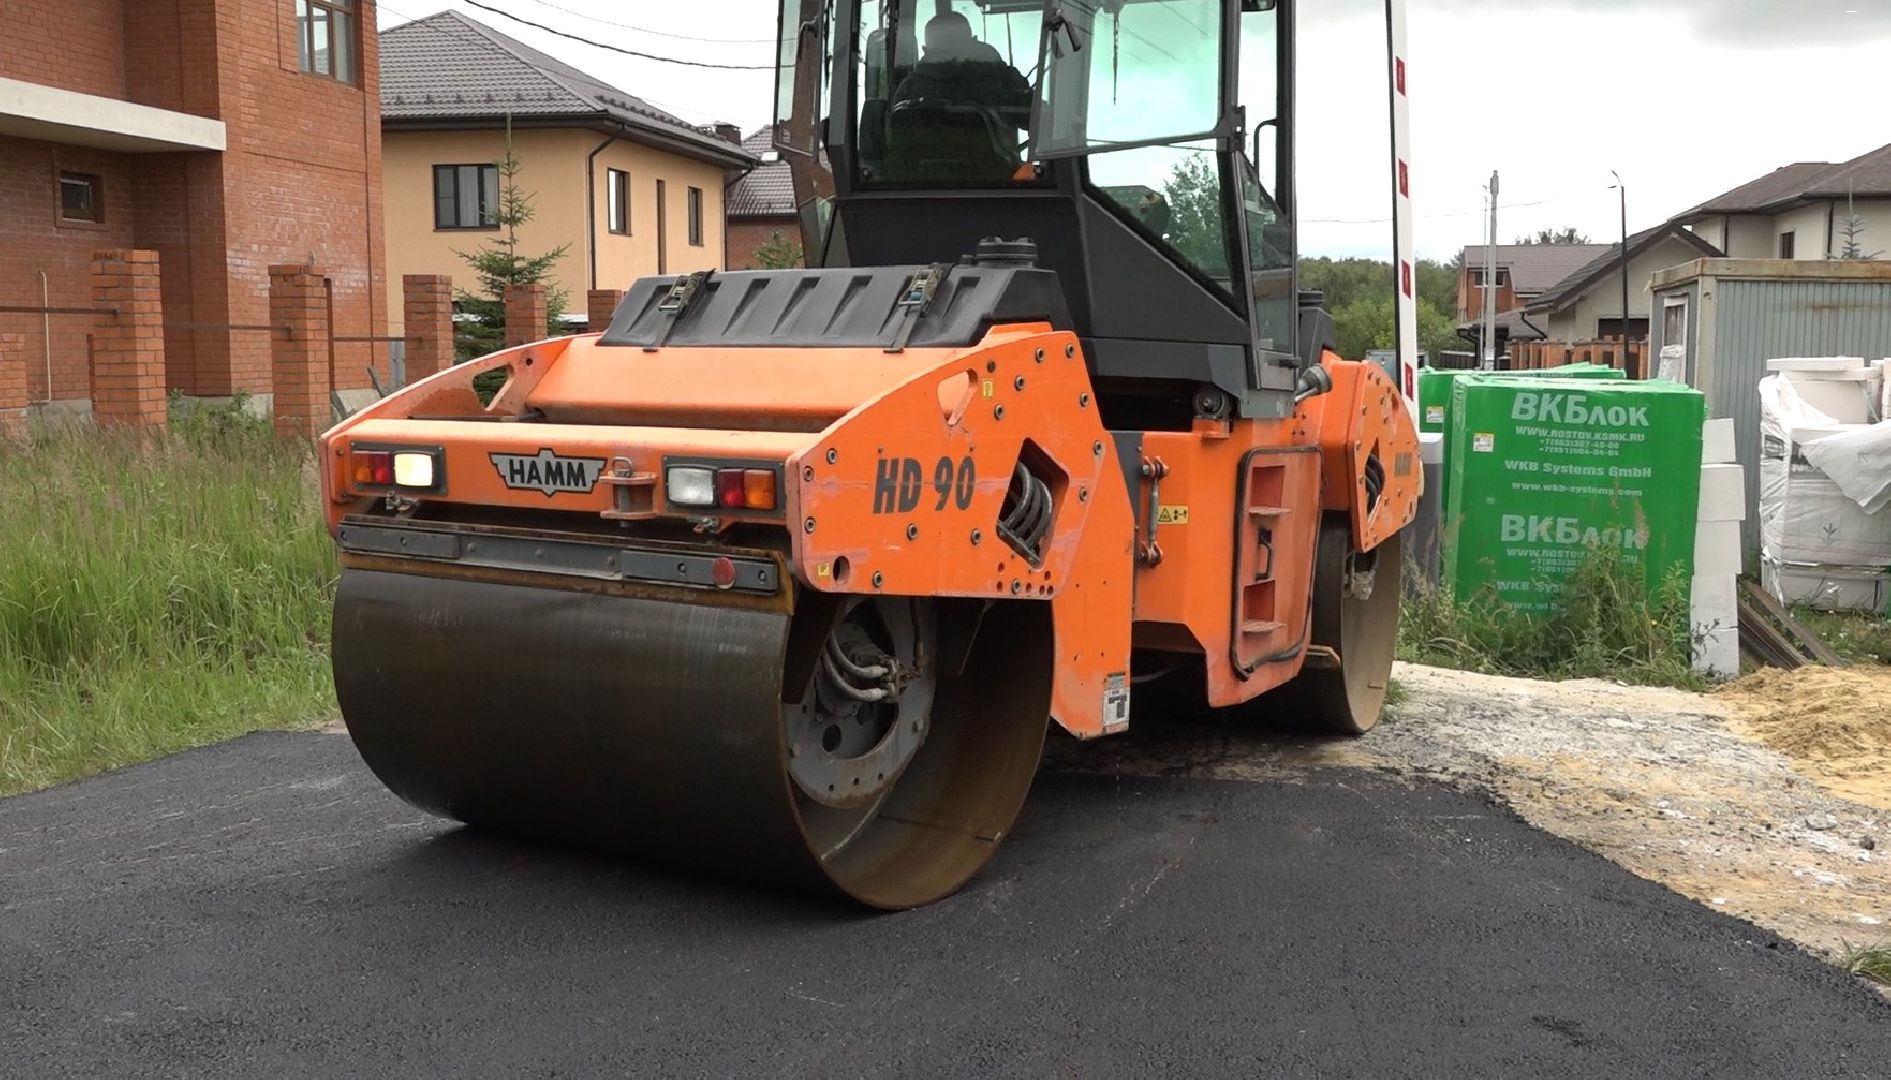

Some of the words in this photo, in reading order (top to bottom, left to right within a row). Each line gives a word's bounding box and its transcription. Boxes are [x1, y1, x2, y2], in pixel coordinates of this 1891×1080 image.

[1511, 392, 1650, 427] ВКБлок
[509, 459, 587, 487] HAMM
[873, 458, 922, 514] HD
[934, 455, 975, 511] 90
[1504, 460, 1539, 471] WKB
[1543, 462, 1604, 476] Systems
[1608, 466, 1652, 478] GmbH
